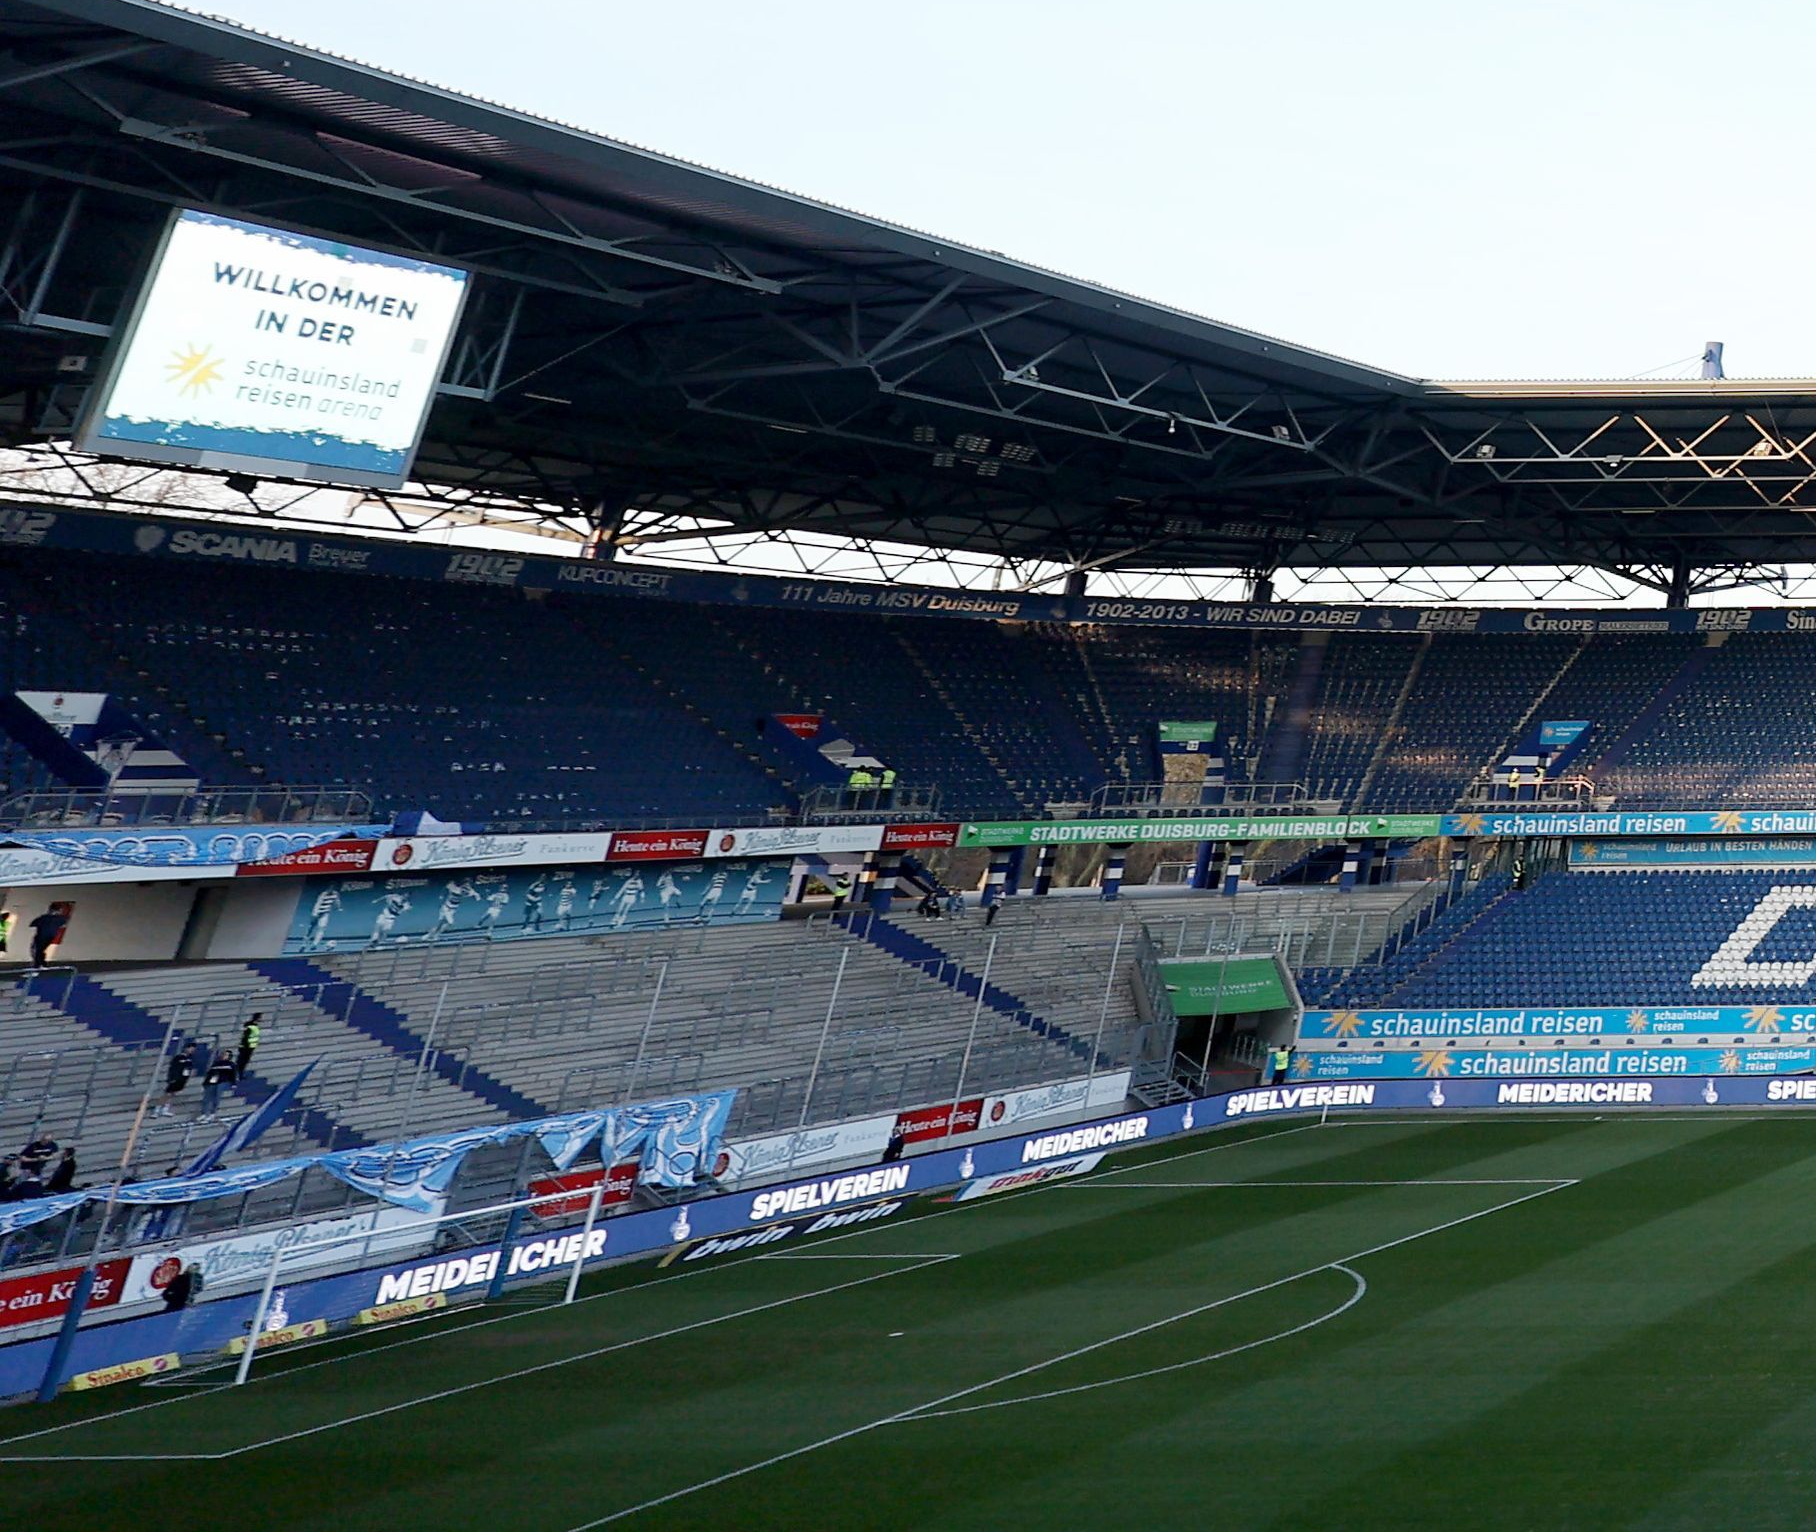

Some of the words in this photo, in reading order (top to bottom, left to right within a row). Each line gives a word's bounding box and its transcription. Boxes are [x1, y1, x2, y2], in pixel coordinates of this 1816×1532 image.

[212, 261, 418, 320] WILLKOMMEN
[255, 308, 286, 333] IN
[297, 316, 356, 347] DER
[317, 396, 383, 422] arena
[168, 530, 297, 563] SCANIA
[781, 585, 812, 602] 111
[817, 588, 872, 607] Jahre
[876, 592, 924, 610] MSV
[928, 595, 1021, 616] Duisburg
[1085, 602, 1187, 622] 1902-2013
[1206, 606, 1246, 622] WIR
[1249, 608, 1296, 624] SIND
[1300, 610, 1360, 625] DABEI
[885, 830, 913, 845] Heute
[929, 827, 955, 846] König
[1030, 822, 1138, 842] STADTWERKE
[1141, 818, 1370, 840] DUISBURG-FAMILIENBLOCK
[1493, 814, 1622, 835] schauinsland
[1626, 813, 1686, 832] reisen
[613, 839, 649, 854] Heute
[650, 839, 667, 852] ein
[669, 836, 703, 856] König
[1666, 840, 1706, 853] URLAUB
[1710, 840, 1721, 852] IN
[1725, 839, 1767, 852] BESTEN
[1771, 837, 1812, 851] HÄNDEN
[297, 850, 321, 866] ein
[324, 847, 369, 869] König
[1370, 1013, 1523, 1037] schauinsland
[1531, 1011, 1602, 1033] reisen
[1460, 1050, 1610, 1075] schauinsland
[1617, 1054, 1687, 1074] reisen
[1226, 1084, 1375, 1116] SPIELVEREIN
[1498, 1081, 1652, 1104] MEIDERICHER
[1022, 1116, 1149, 1164] MEIDERICHER
[750, 1164, 911, 1221] SPIELVEREIN
[804, 1199, 903, 1235] bwin
[683, 1225, 793, 1262] bwin
[9, 1290, 34, 1311] ein
[86, 1363, 145, 1387] Sinalco
